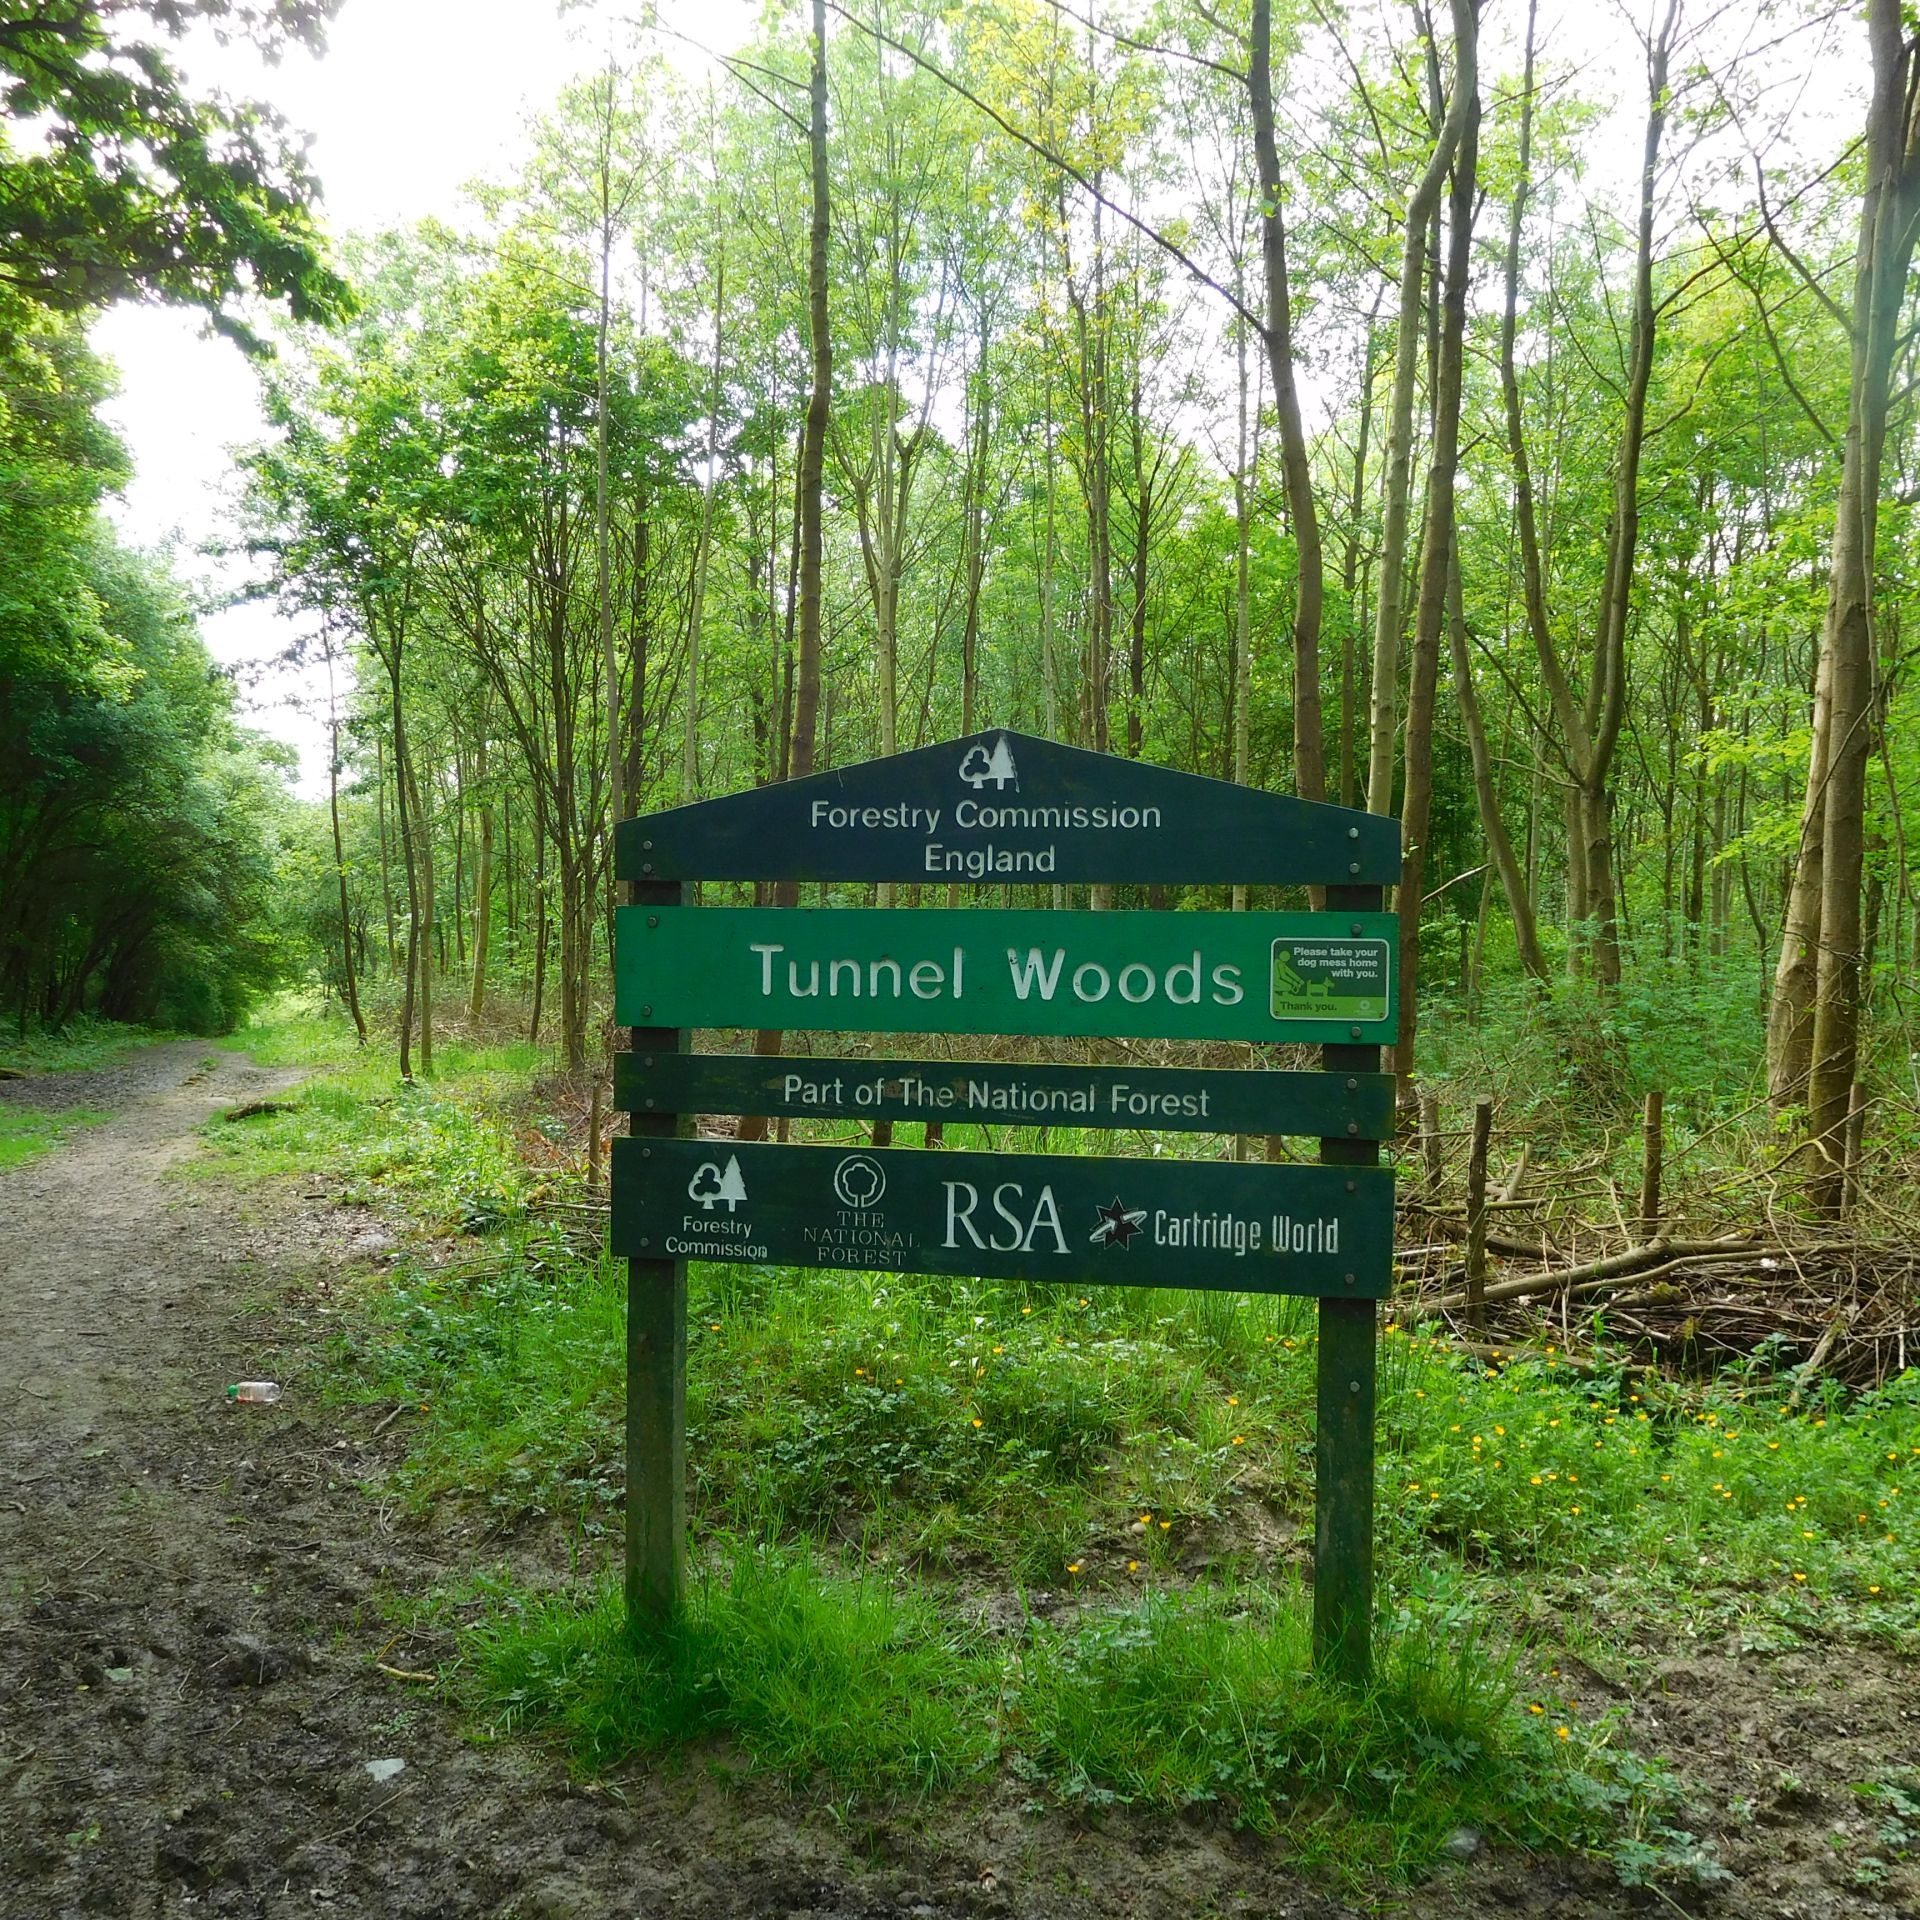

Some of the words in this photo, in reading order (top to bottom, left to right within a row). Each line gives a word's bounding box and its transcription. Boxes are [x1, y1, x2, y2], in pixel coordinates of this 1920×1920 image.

[811, 800, 941, 835] Forestry
[956, 799, 1161, 829] Commission
[925, 843, 1055, 879] England
[1293, 946, 1327, 956] Please
[1330, 947, 1353, 956] take
[1355, 949, 1378, 958] your
[1297, 957, 1316, 968] dog
[1319, 959, 1346, 967] mess
[1349, 958, 1378, 967] home
[749, 943, 964, 999] Tunnel
[1006, 947, 1245, 1005] Woods
[1331, 969, 1353, 977] with
[1356, 970, 1378, 979] you.
[1280, 1001, 1312, 1010] Thank
[1315, 1003, 1337, 1012] you.
[784, 1074, 842, 1104] Part
[855, 1076, 885, 1106] of
[899, 1078, 954, 1109] The
[968, 1080, 1095, 1113] National
[1111, 1084, 1210, 1118] Forest
[683, 1216, 752, 1238] Forestry
[836, 1211, 885, 1229] THE
[940, 1180, 1072, 1254] RSA
[803, 1226, 920, 1248] NATIONAL
[1154, 1209, 1261, 1256] Cartridge
[1272, 1215, 1339, 1254] World
[665, 1237, 768, 1258] Commission
[817, 1247, 907, 1266] FOREST
